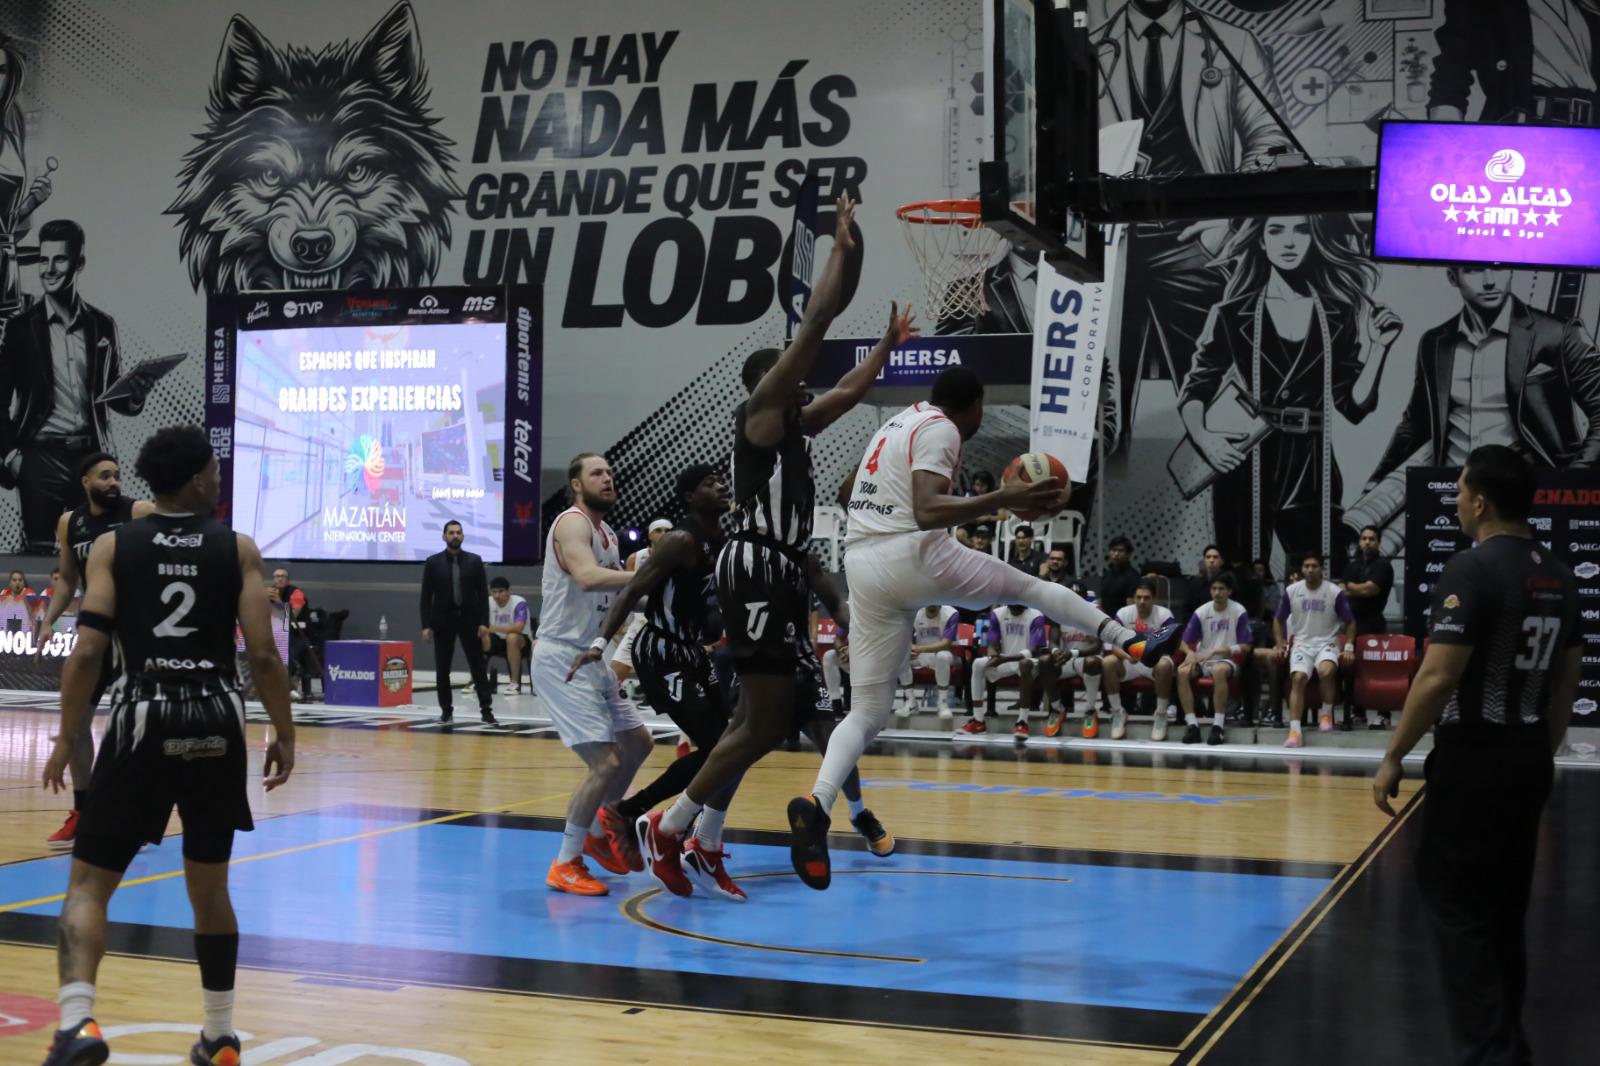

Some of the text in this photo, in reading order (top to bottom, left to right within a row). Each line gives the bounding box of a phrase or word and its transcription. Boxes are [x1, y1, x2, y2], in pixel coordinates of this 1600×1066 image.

[481, 30, 680, 93] NO HAY
[472, 59, 857, 164] NADA MÁS
[465, 156, 868, 220] GRANDE QUE SER
[1430, 183, 1572, 207] OLAS ALTAS
[1457, 227, 1544, 239] Hotel & Spa
[463, 226, 555, 285] UN
[561, 210, 864, 329] LOBO
[298, 301, 323, 315] TVP
[213, 327, 225, 383] HERSA
[299, 349, 436, 371] ESPACIOS QUE INSPIRAN
[517, 306, 533, 402] dportenis
[889, 349, 962, 366] HERSA
[279, 384, 462, 412] GRANDES EXPERIENCIAS
[514, 418, 533, 483] telcel
[323, 502, 406, 528] MAZATLÁN
[323, 530, 406, 543] INTERNATIONAL CENTER
[158, 563, 198, 576] BUGGS
[152, 581, 199, 637] 2
[1515, 616, 1561, 670] 37
[328, 664, 375, 682] VENADOS
